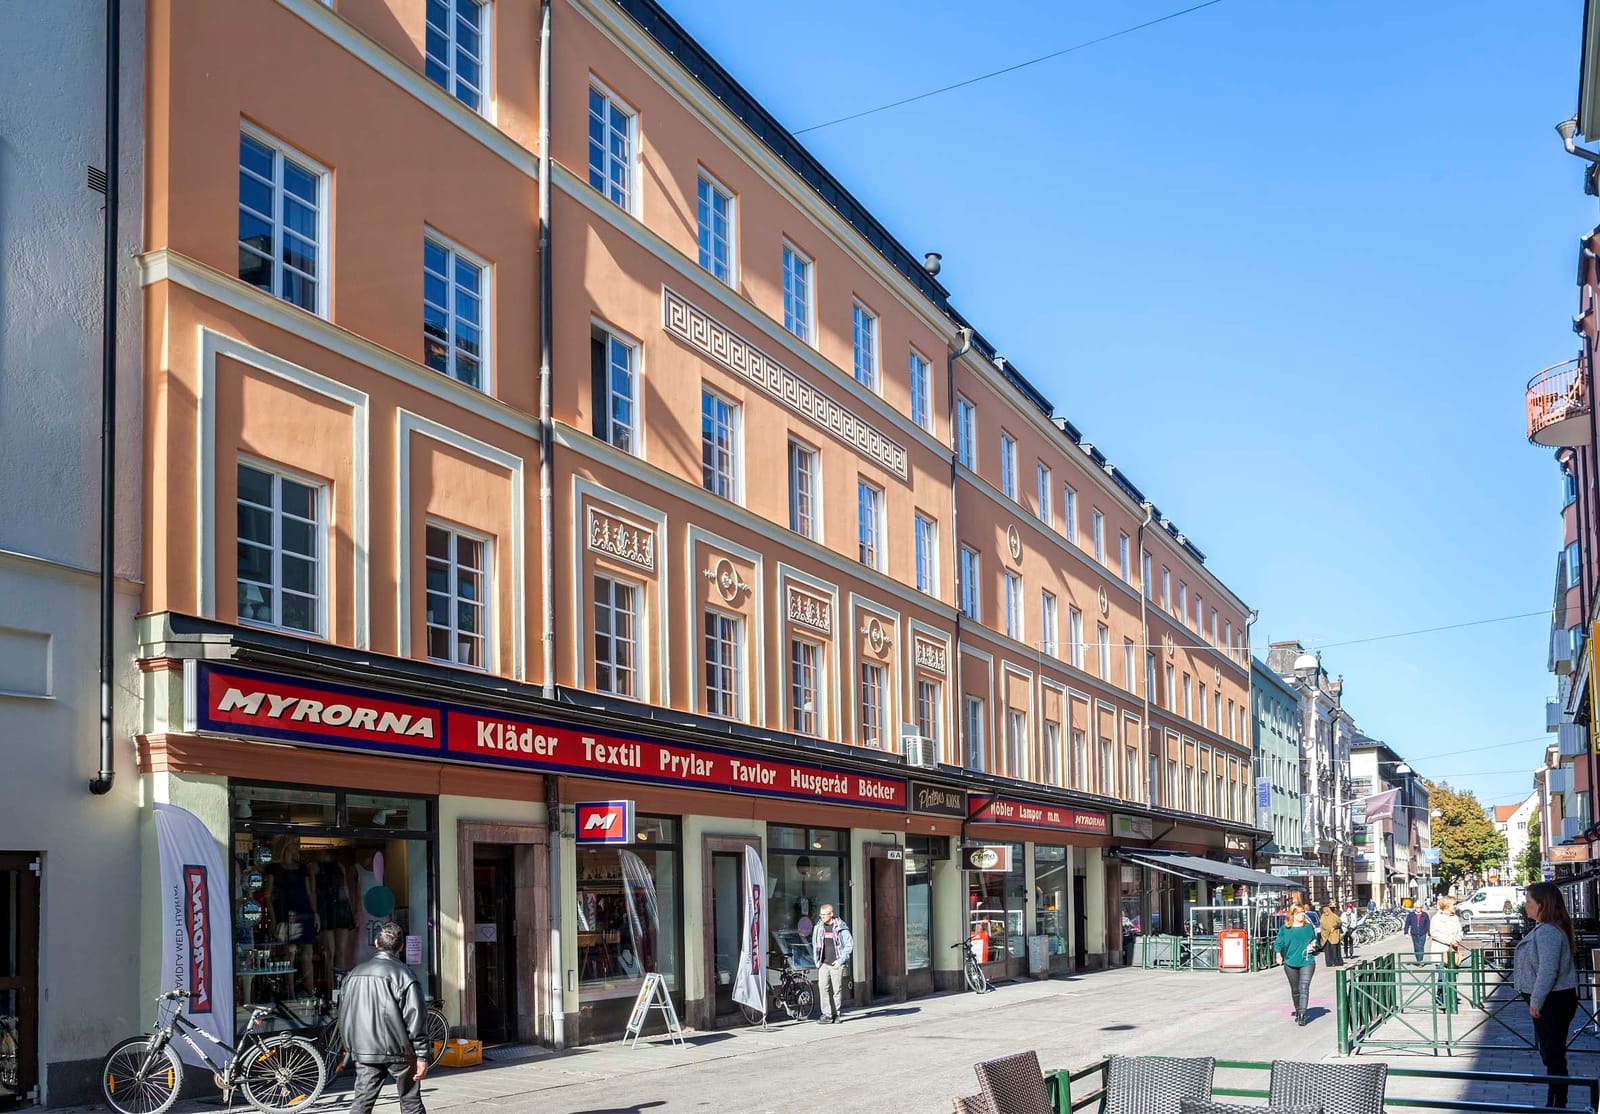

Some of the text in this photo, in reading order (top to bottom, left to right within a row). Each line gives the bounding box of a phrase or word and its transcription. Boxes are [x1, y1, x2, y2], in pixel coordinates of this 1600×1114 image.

[217, 687, 434, 739] MYRORNA
[476, 720, 895, 800] Kläder Textil Prylar Tavlor Husgeråd Böcker
[584, 813, 617, 830] M
[1019, 804, 1042, 823] Lampor
[1075, 815, 1105, 827] MYRORNA
